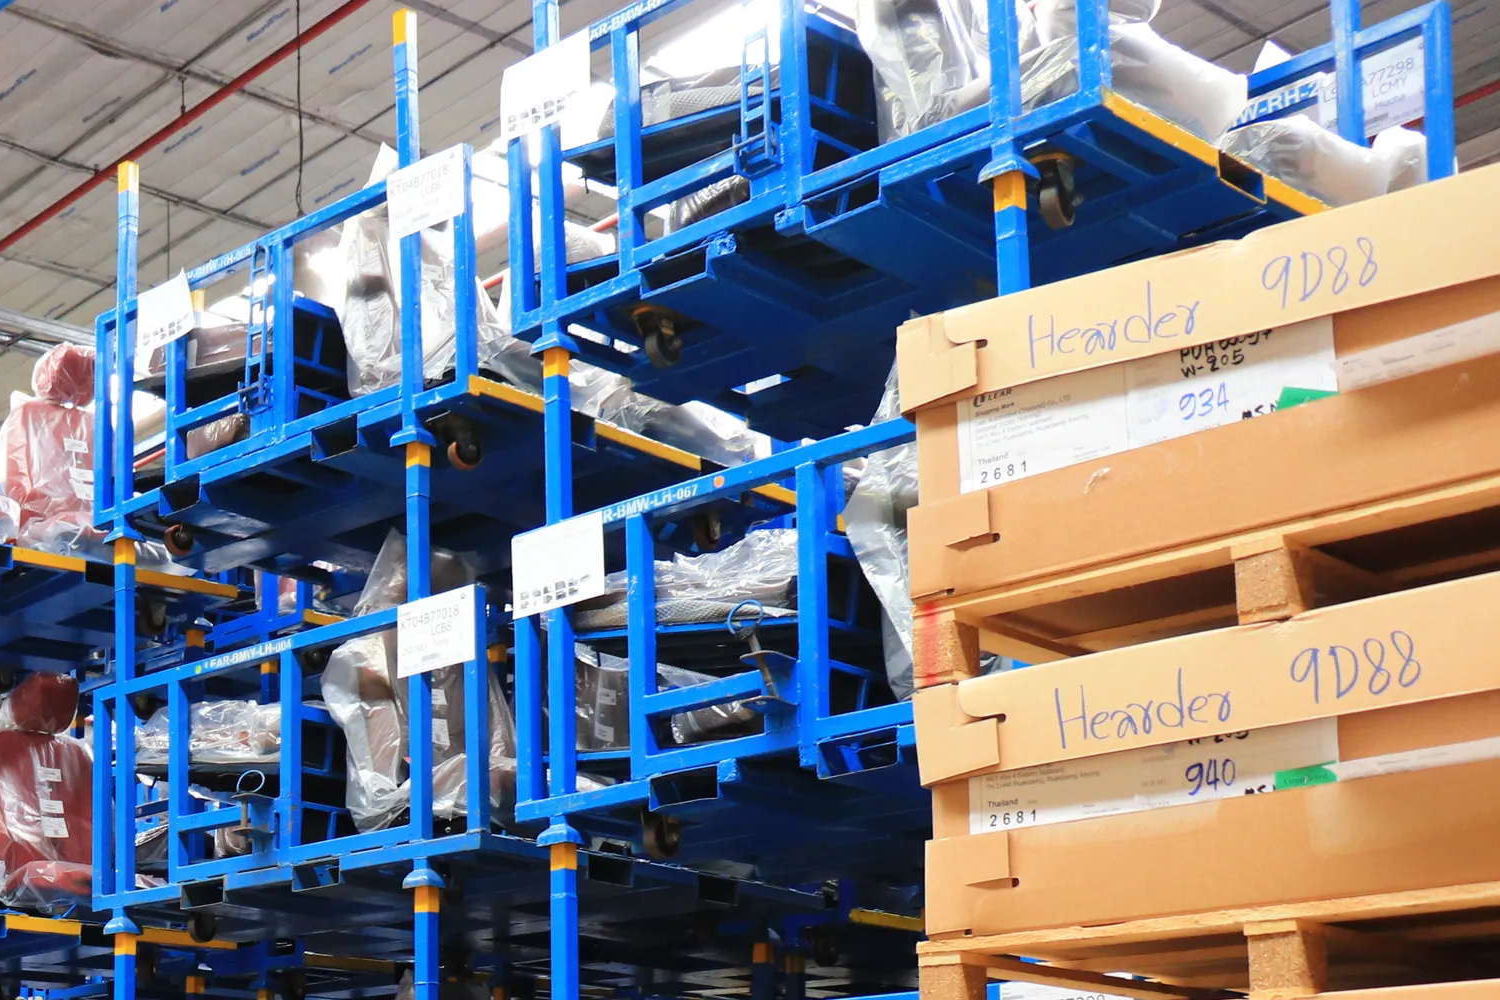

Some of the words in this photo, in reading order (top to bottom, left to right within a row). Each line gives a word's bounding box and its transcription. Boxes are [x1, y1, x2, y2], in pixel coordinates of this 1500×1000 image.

[1262, 238, 1378, 308] 9D88
[988, 388, 1012, 401] LEAR
[978, 452, 1009, 467] Thailand
[400, 604, 460, 631] KT04B77018
[431, 621, 452, 636] LCB8
[1290, 631, 1422, 704] 9D88
[1185, 758, 1236, 796] 940
[988, 798, 1019, 808] Thailand
